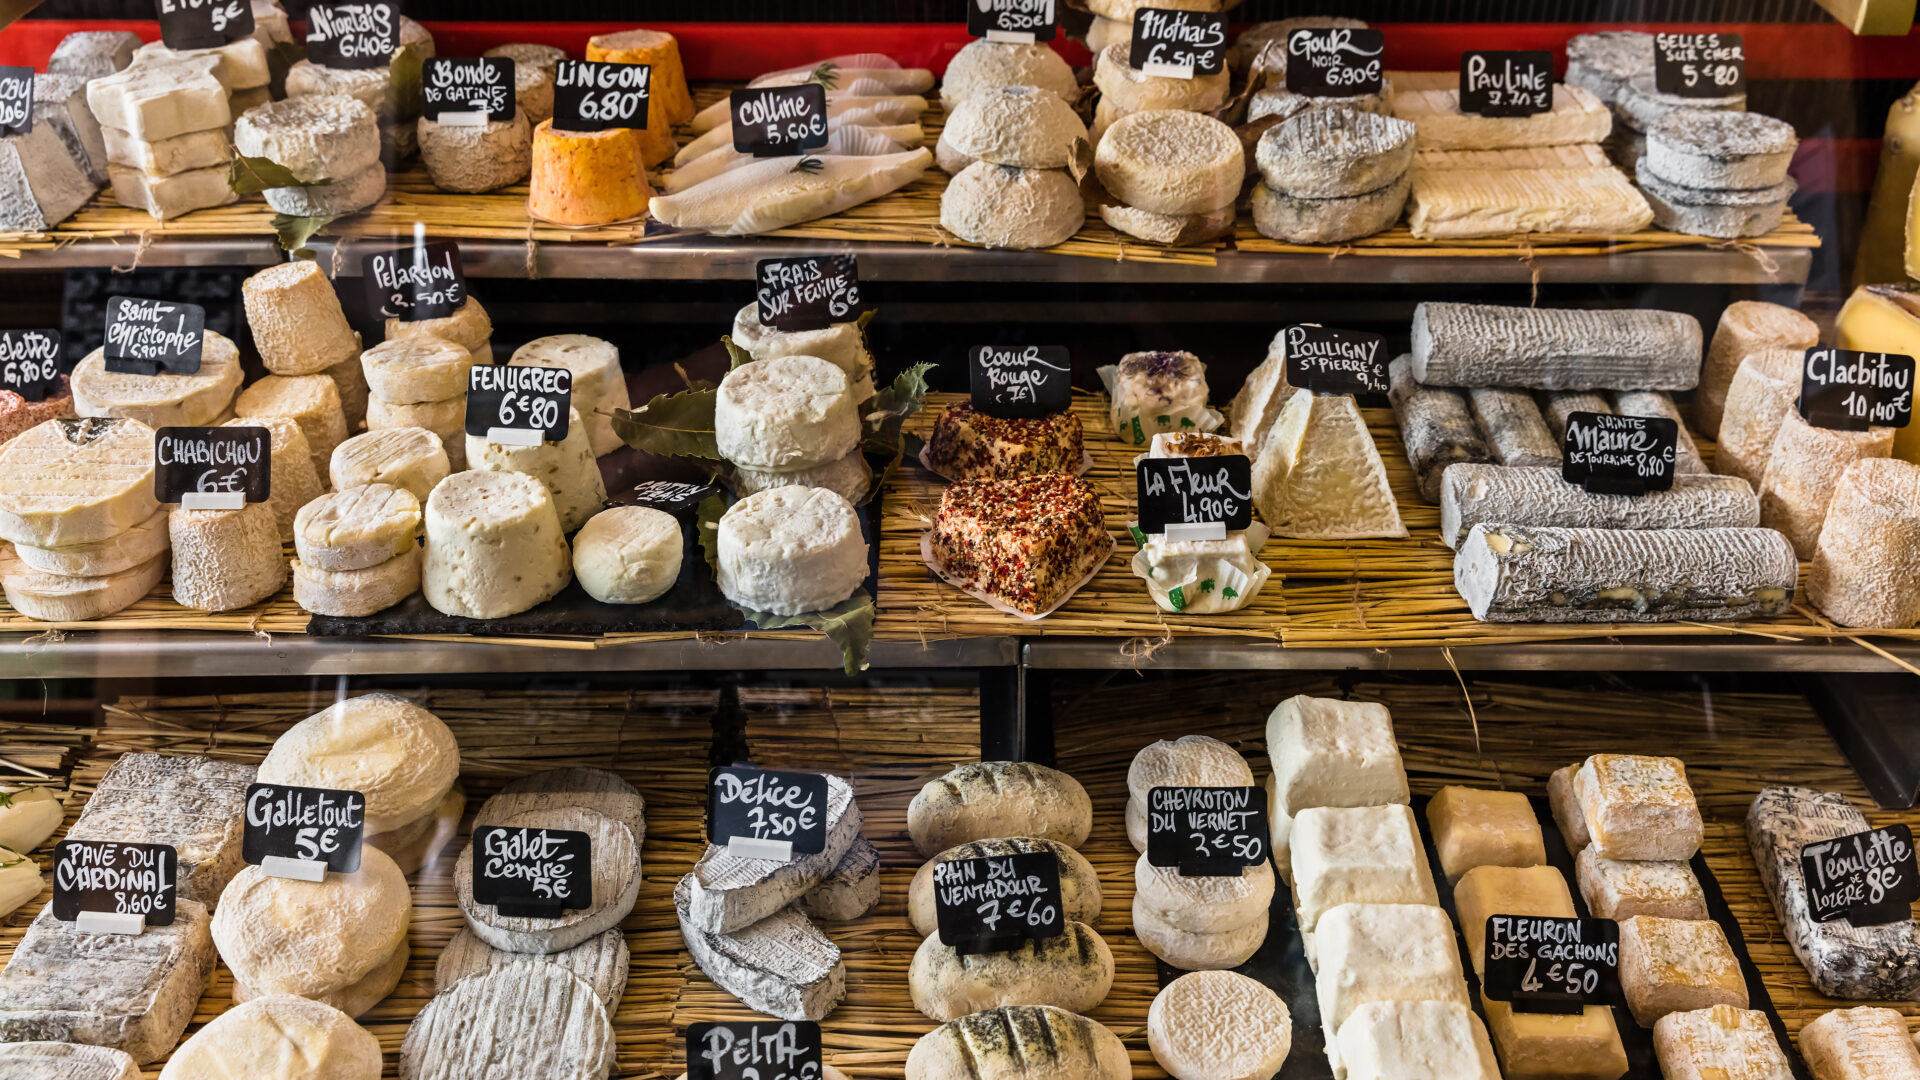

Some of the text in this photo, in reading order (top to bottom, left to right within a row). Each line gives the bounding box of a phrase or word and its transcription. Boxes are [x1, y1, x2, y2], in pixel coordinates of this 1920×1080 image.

[339, 34, 395, 57] 6,40€
[1656, 33, 1721, 51] SELLES
[1666, 47, 1745, 61] SUR CHER
[432, 57, 502, 88] Bonde
[1326, 59, 1381, 85] 6,90€
[579, 89, 650, 121] 6,80€
[829, 286, 861, 317] 6€
[471, 365, 569, 395] FENUGREC
[1841, 391, 1912, 422] 10,40€
[196, 467, 248, 493] 6€
[1144, 466, 1166, 497] LA
[1182, 490, 1239, 523] 4,90€
[1152, 787, 1250, 811] CHEVROTON
[747, 806, 818, 840] 7,50€
[1150, 809, 1260, 833] DU VERNET
[294, 827, 340, 860] 5€
[485, 828, 570, 862] Galet
[123, 847, 155, 868] DU
[987, 857, 1017, 879] DU
[532, 877, 572, 899] 5€
[941, 875, 1049, 906] VENTADOUR
[1850, 871, 1864, 885] DE
[1866, 866, 1902, 905] 8€
[114, 892, 168, 915] 8,60€
[1492, 916, 1581, 943] FLEURON
[1491, 941, 1618, 967] DES GACHONS
